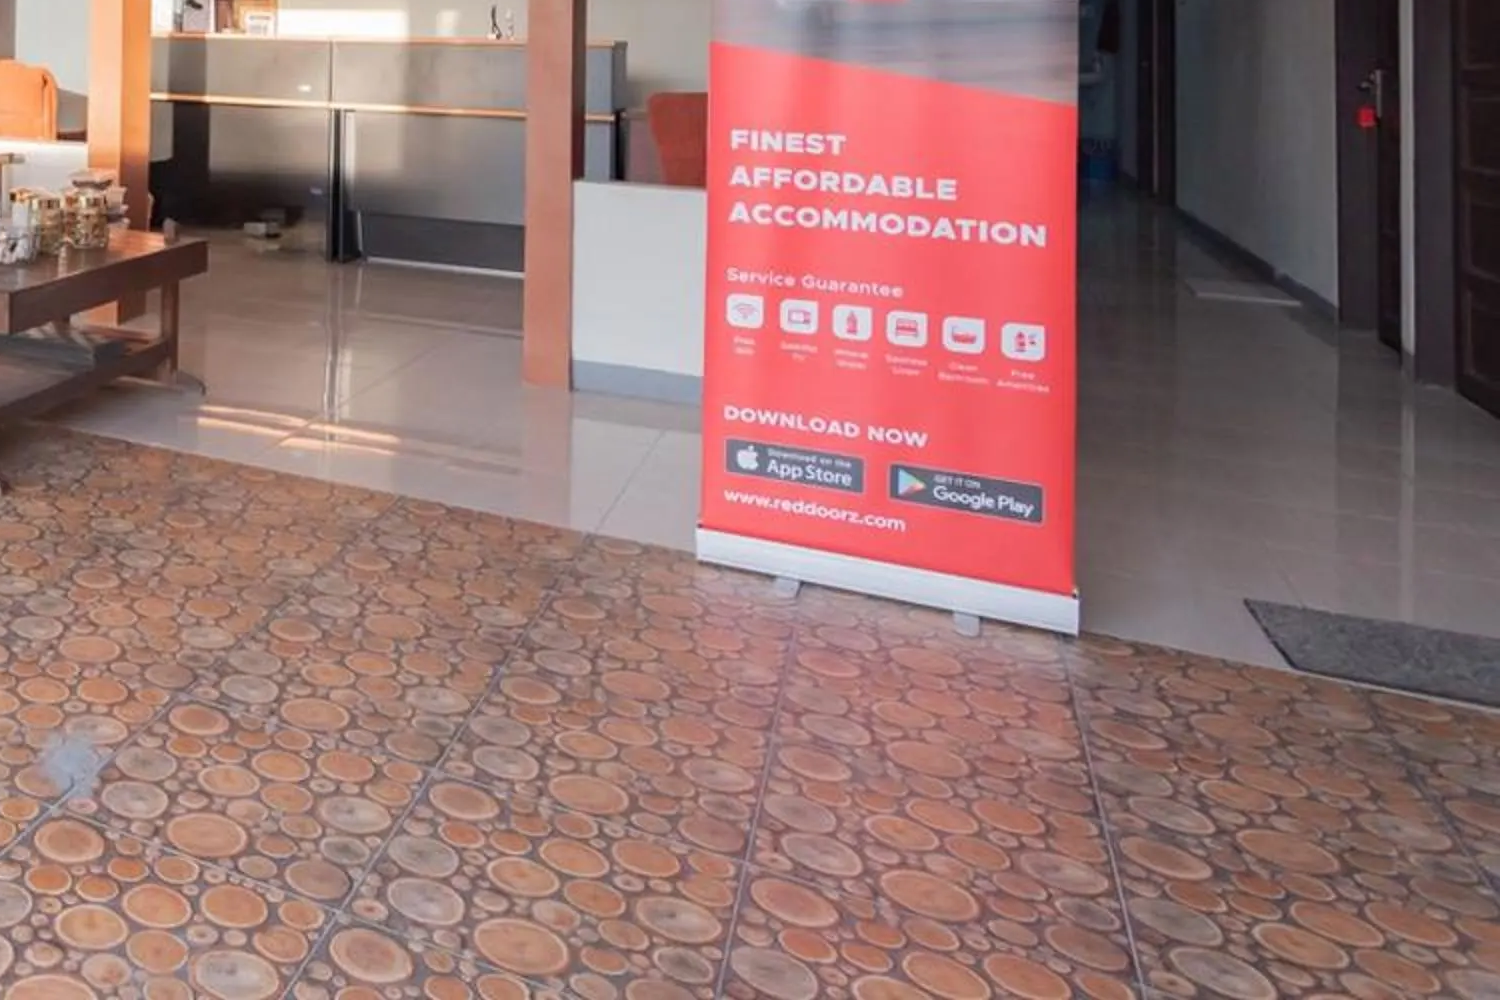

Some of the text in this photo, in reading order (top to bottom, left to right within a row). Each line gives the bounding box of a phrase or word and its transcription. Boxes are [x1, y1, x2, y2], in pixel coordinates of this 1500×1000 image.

[730, 129, 846, 155] FINEST
[729, 165, 958, 201] AFFORDABLE
[728, 201, 1047, 247] ACCOMMODATION
[726, 267, 904, 298] Service Guarantee
[723, 405, 929, 448] DOWNLOAD NOW
[766, 459, 853, 487] App Store
[723, 489, 906, 532] www.reddoorz.com
[933, 485, 1035, 518] Google Play
